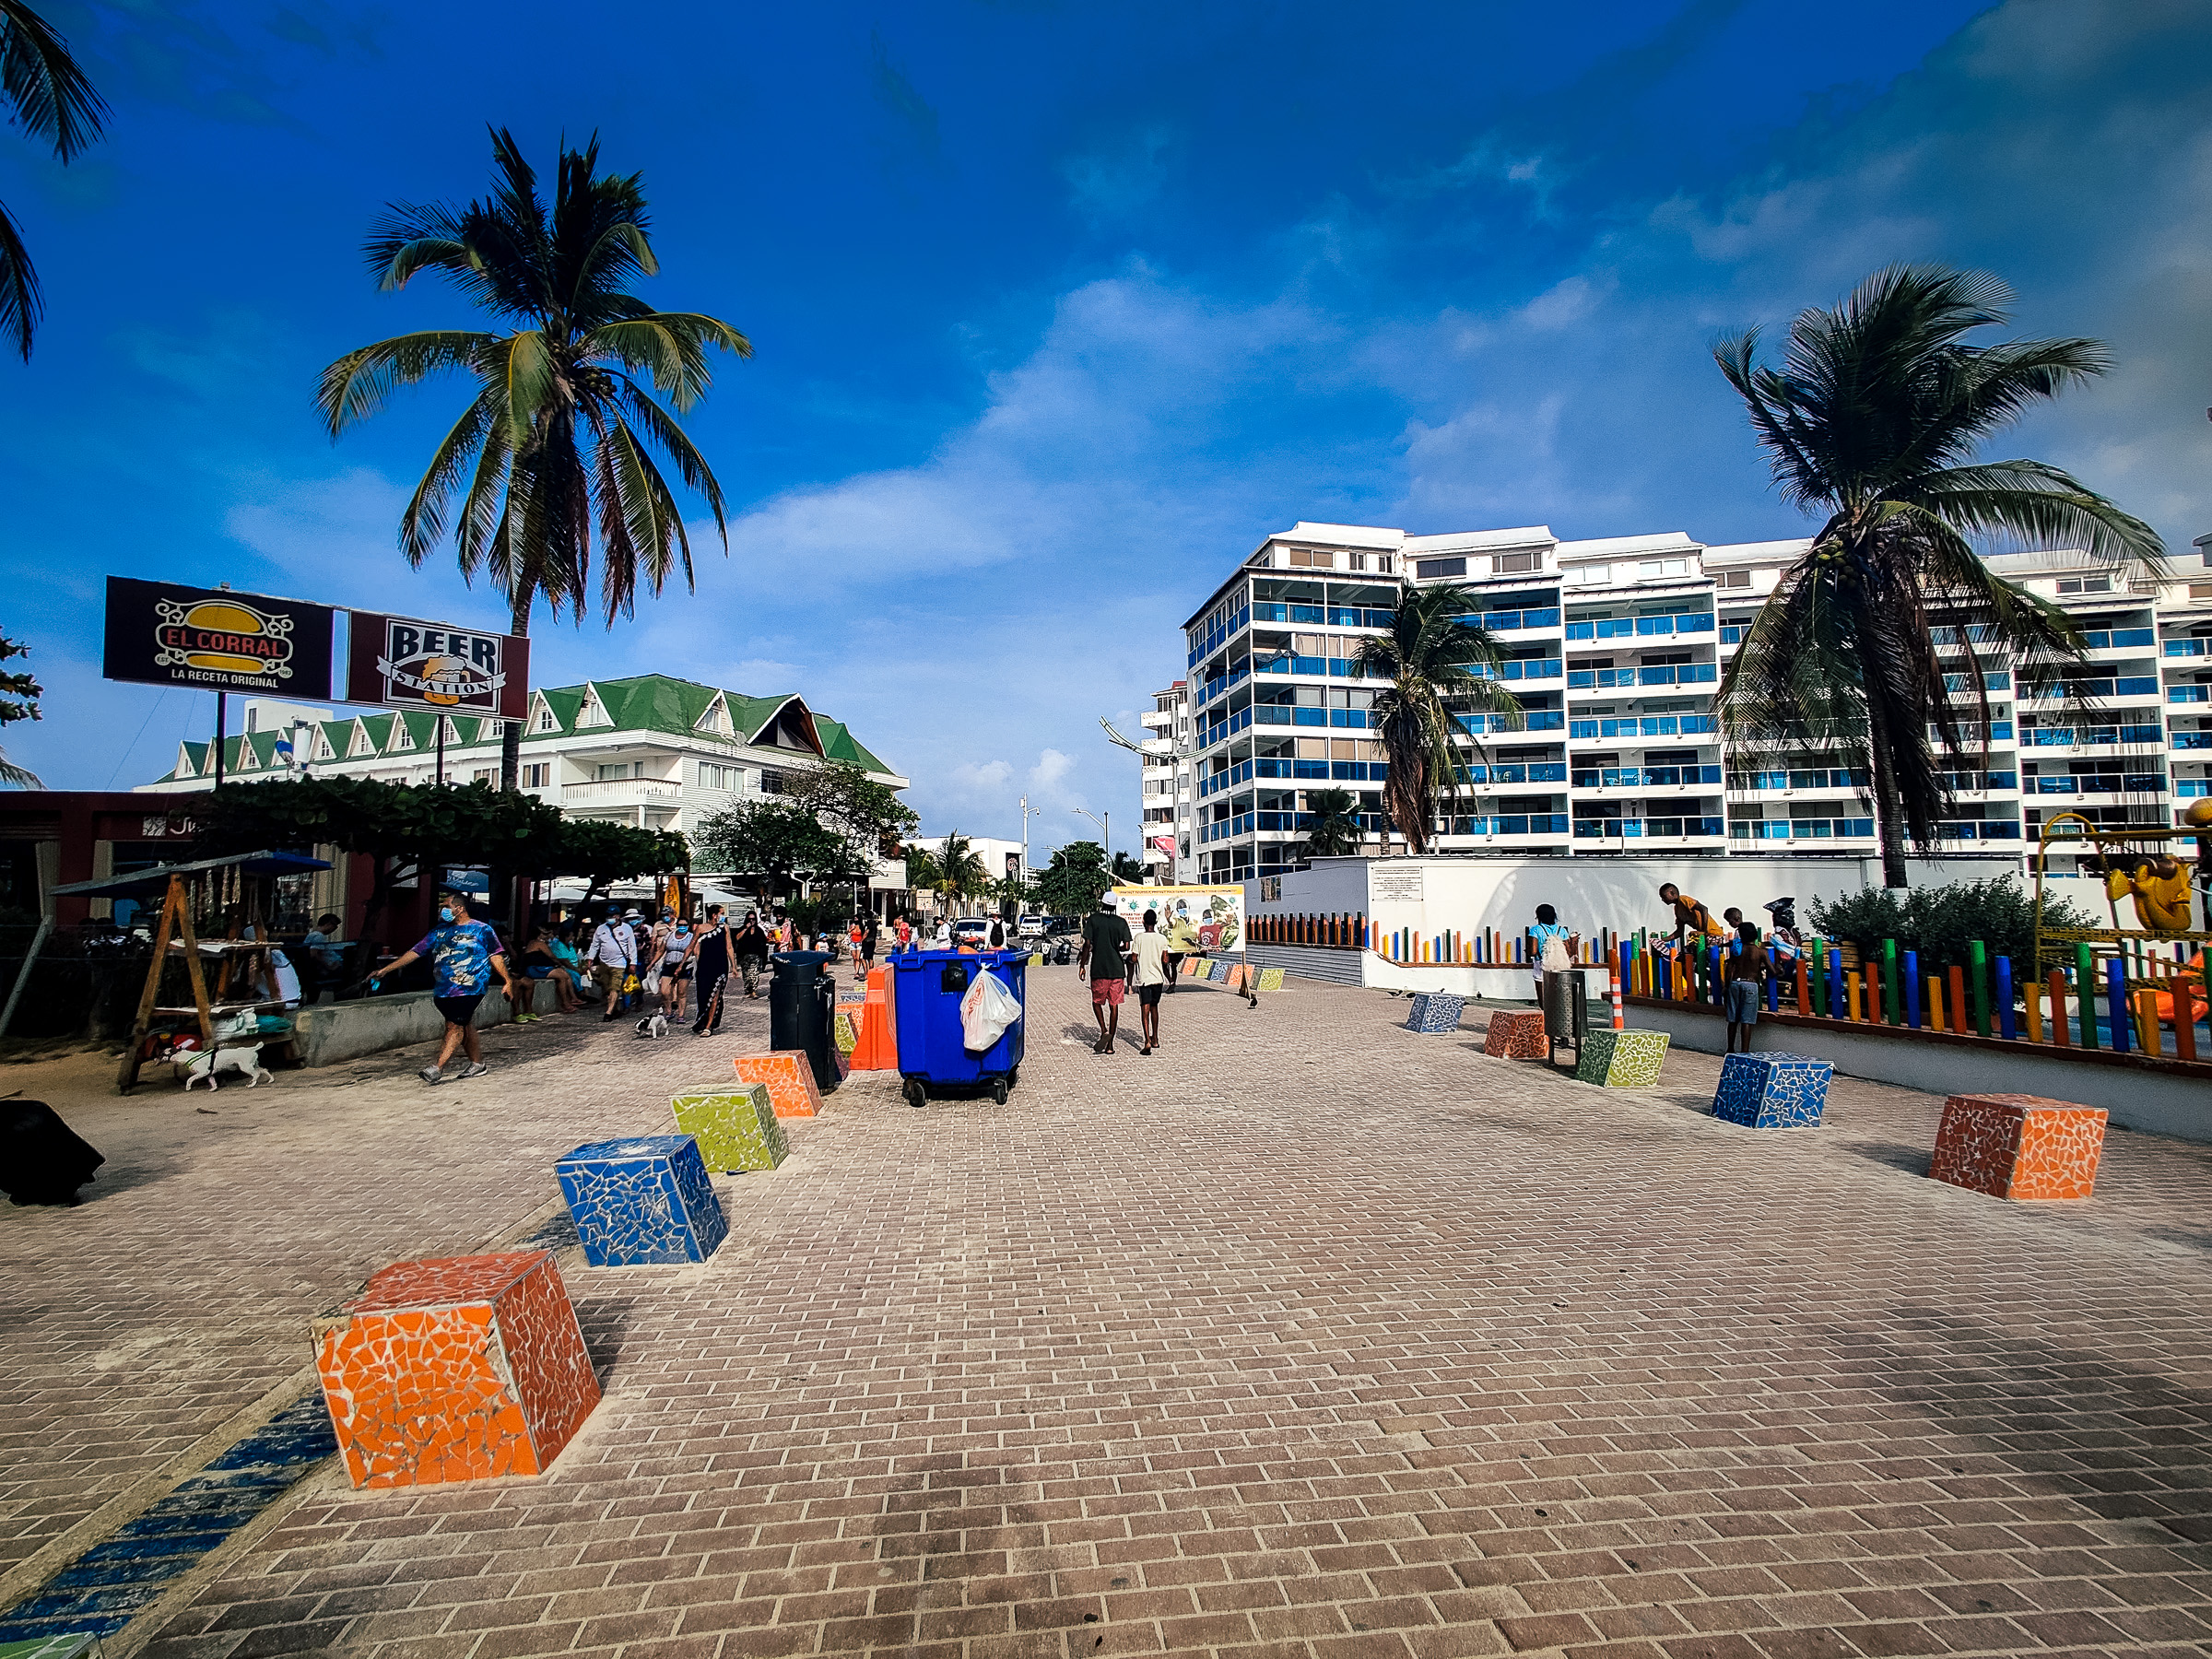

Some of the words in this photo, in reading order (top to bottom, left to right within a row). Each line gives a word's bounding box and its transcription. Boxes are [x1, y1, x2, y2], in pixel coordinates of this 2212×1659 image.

[167, 629, 193, 647] EL
[197, 632, 284, 657] CORRAL
[392, 626, 496, 676] BEER
[171, 669, 185, 678] LA
[188, 670, 229, 683] RECETA
[230, 674, 278, 688] ORIGINAL
[395, 672, 489, 694] STATION
